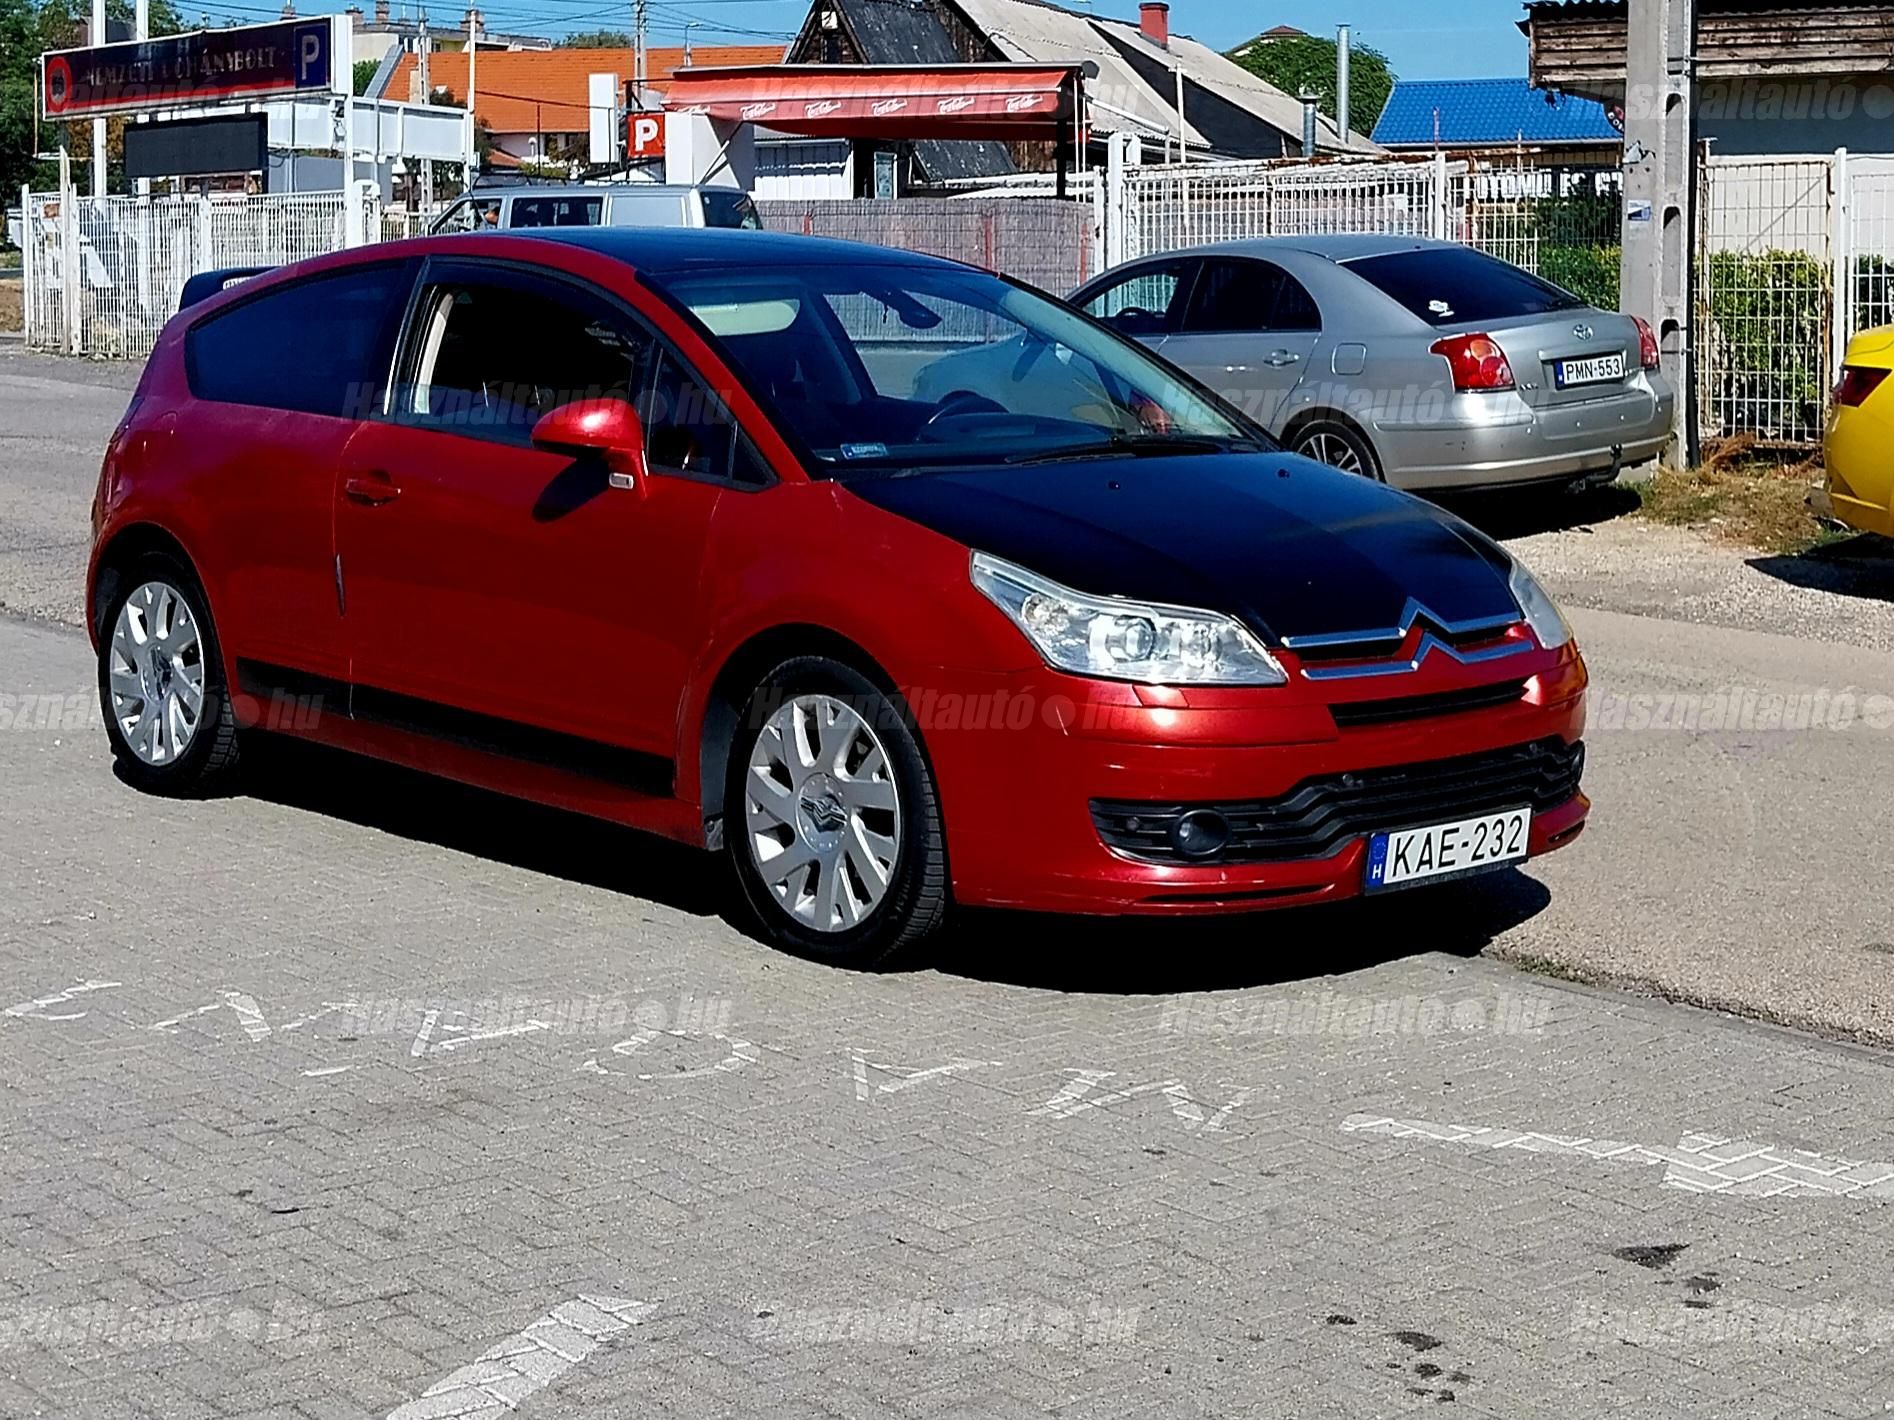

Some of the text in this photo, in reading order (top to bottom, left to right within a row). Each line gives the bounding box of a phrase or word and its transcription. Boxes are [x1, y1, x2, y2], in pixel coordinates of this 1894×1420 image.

[301, 34, 320, 80] P
[634, 118, 658, 151] P
[1565, 358, 1620, 382] PMN-553
[1391, 814, 1523, 878] KAE-232
[1371, 862, 1383, 880] H
